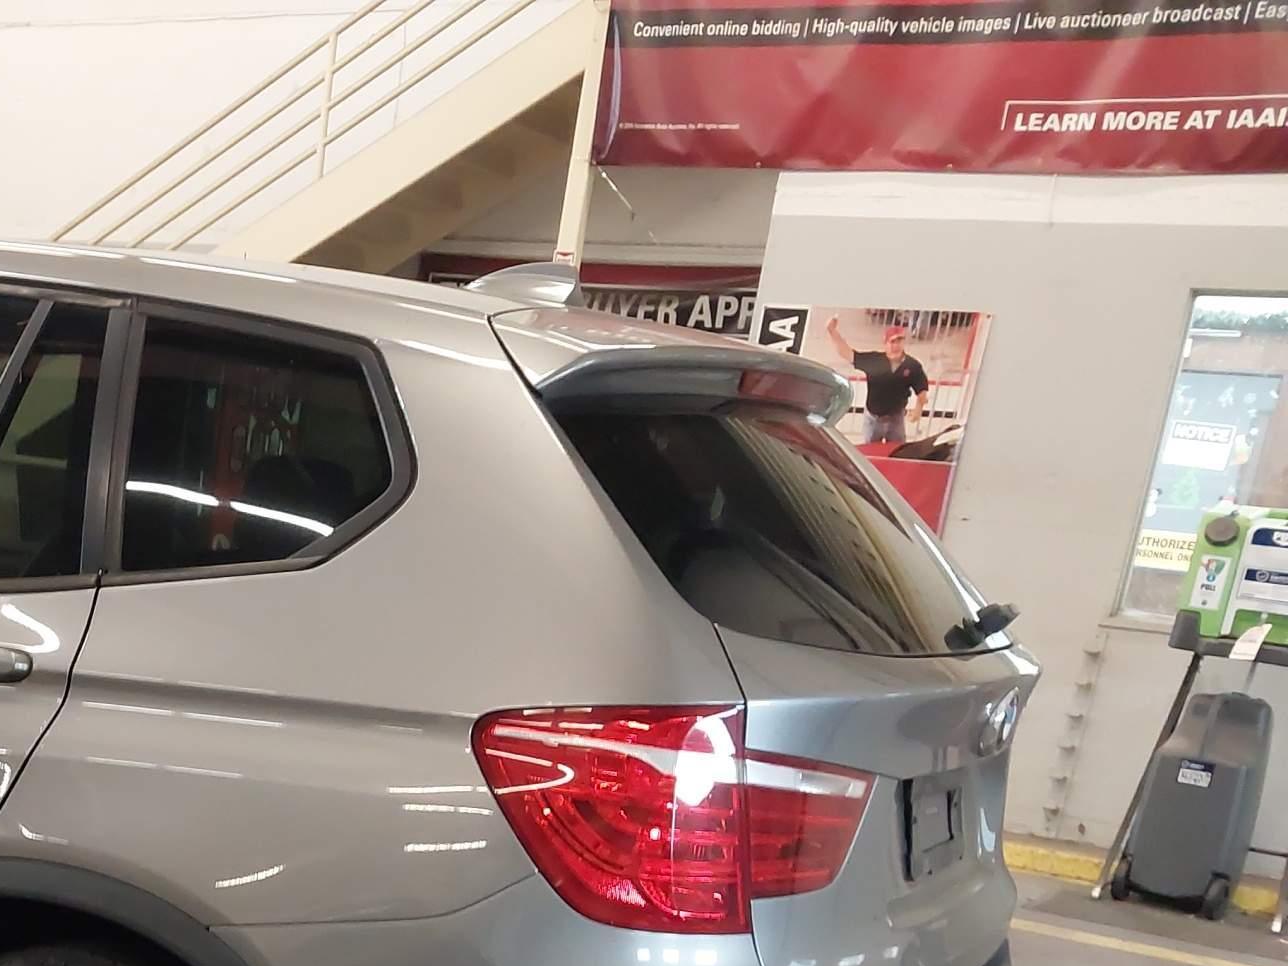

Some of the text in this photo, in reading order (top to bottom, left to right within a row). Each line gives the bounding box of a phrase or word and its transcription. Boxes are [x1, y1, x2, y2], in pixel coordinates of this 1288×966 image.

[633, 20, 704, 37] Convenient
[707, 19, 748, 37] online
[751, 19, 800, 37] bidding
[812, 17, 898, 37] High-quality
[902, 16, 954, 34] vehicle
[957, 16, 1011, 35] images
[1024, 12, 1056, 29] Live
[1060, 9, 1148, 29] auctioneer
[1152, 3, 1241, 24] broadcast
[1254, 1, 1288, 22] Eas
[1014, 112, 1096, 132] LEARN
[1102, 110, 1181, 131] MORE
[1183, 110, 1222, 130] AT
[1173, 422, 1232, 443] NOTICE
[1138, 536, 1197, 551] UTHORIZE
